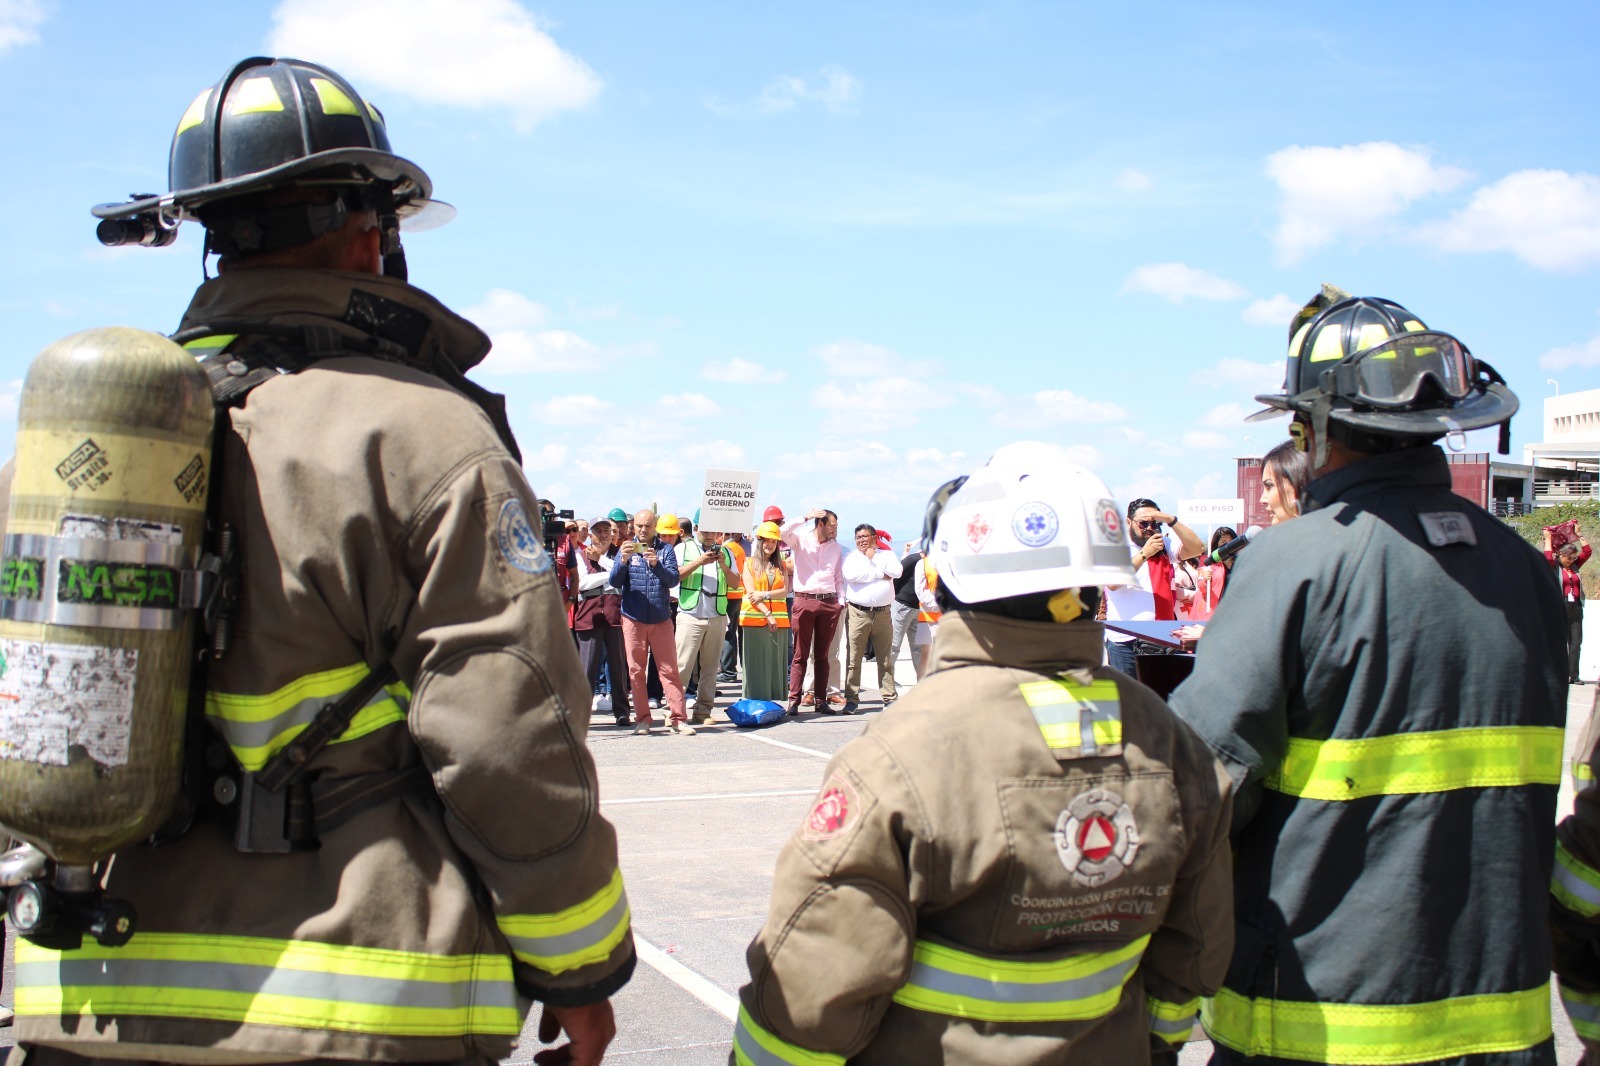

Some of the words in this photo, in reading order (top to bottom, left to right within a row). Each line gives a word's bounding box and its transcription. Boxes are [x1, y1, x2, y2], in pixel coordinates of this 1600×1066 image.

[58, 443, 97, 479] MSA
[710, 482, 752, 490] SECRETARÍA
[705, 490, 742, 498] GENERAL
[744, 491, 755, 499] DE
[708, 499, 750, 508] GOBIERNO
[66, 563, 175, 604] MSA
[1103, 886, 1153, 900] ESTATAL
[1157, 884, 1170, 896] DE
[1117, 900, 1157, 915] CIVIL
